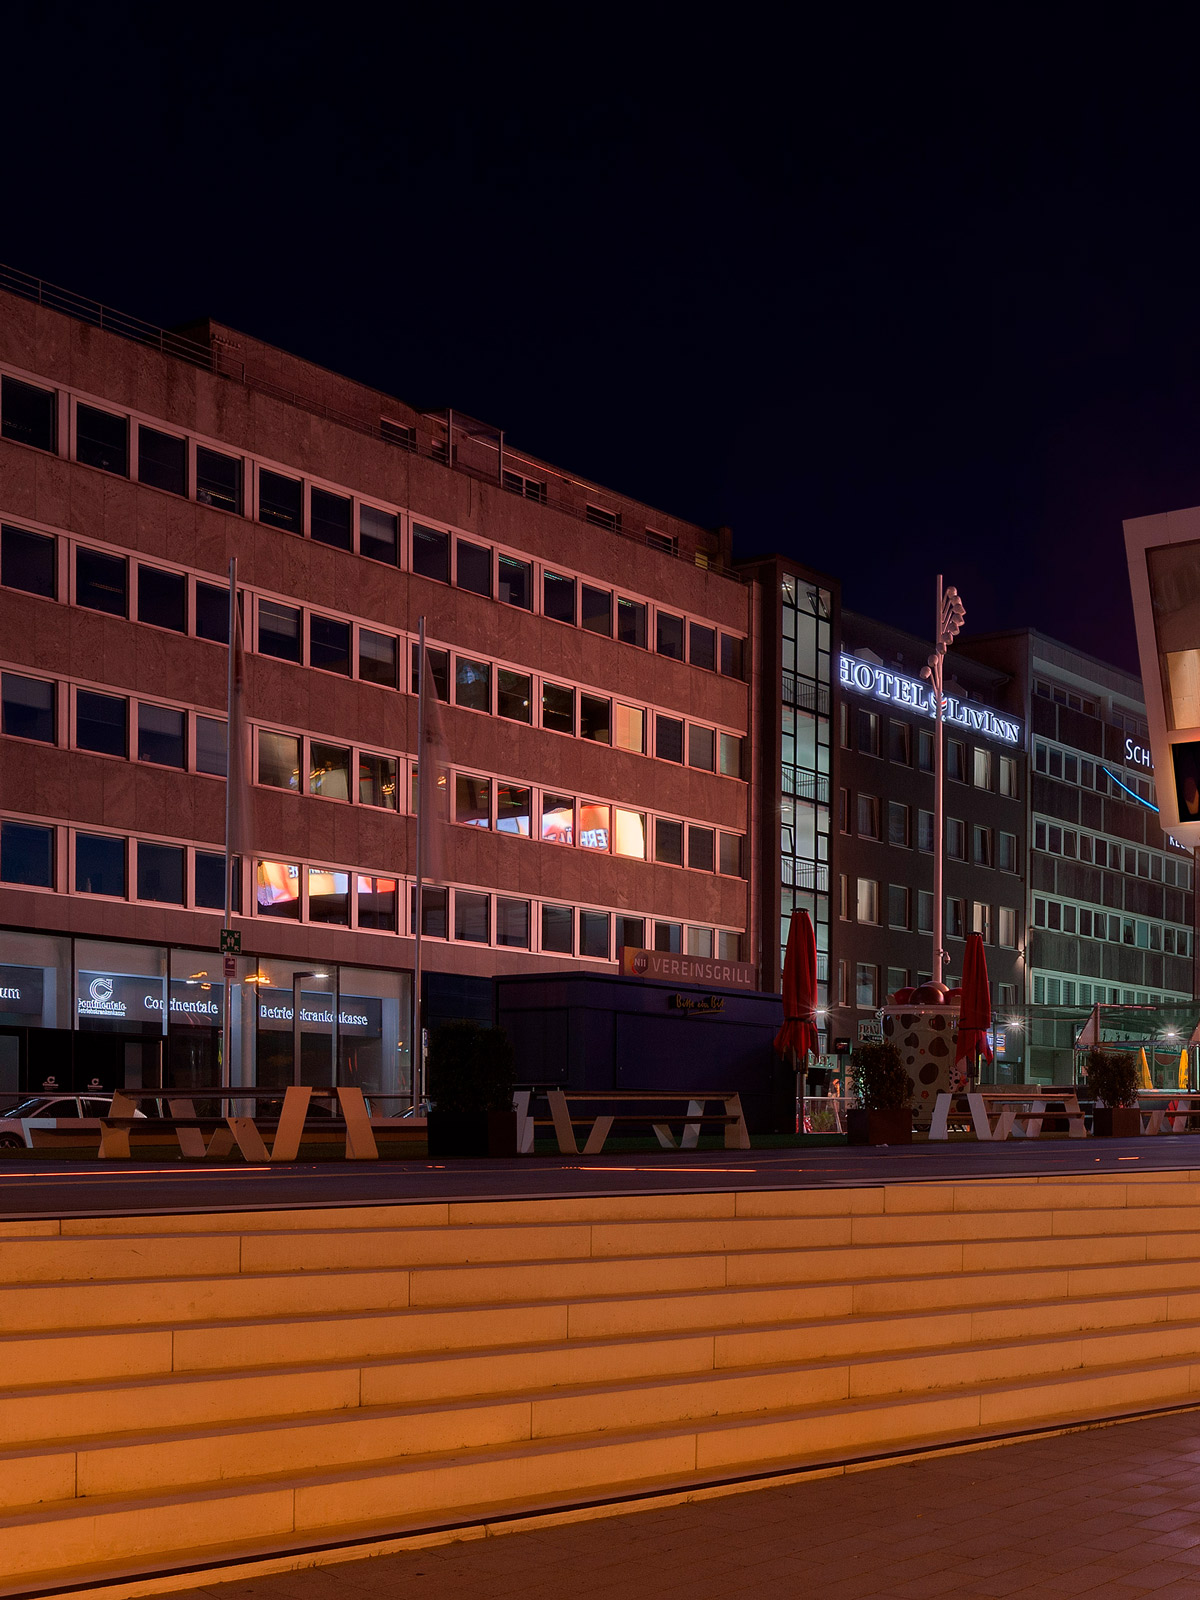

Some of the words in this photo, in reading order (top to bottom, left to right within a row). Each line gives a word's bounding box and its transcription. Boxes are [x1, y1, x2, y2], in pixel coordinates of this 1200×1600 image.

[840, 655, 929, 711] HOTEL
[1125, 738, 1155, 769] SCH
[652, 957, 751, 983] VEREINSGRILL
[675, 993, 695, 1009] Bitte
[696, 1001, 710, 1009] ein
[710, 994, 725, 1008] Bit
